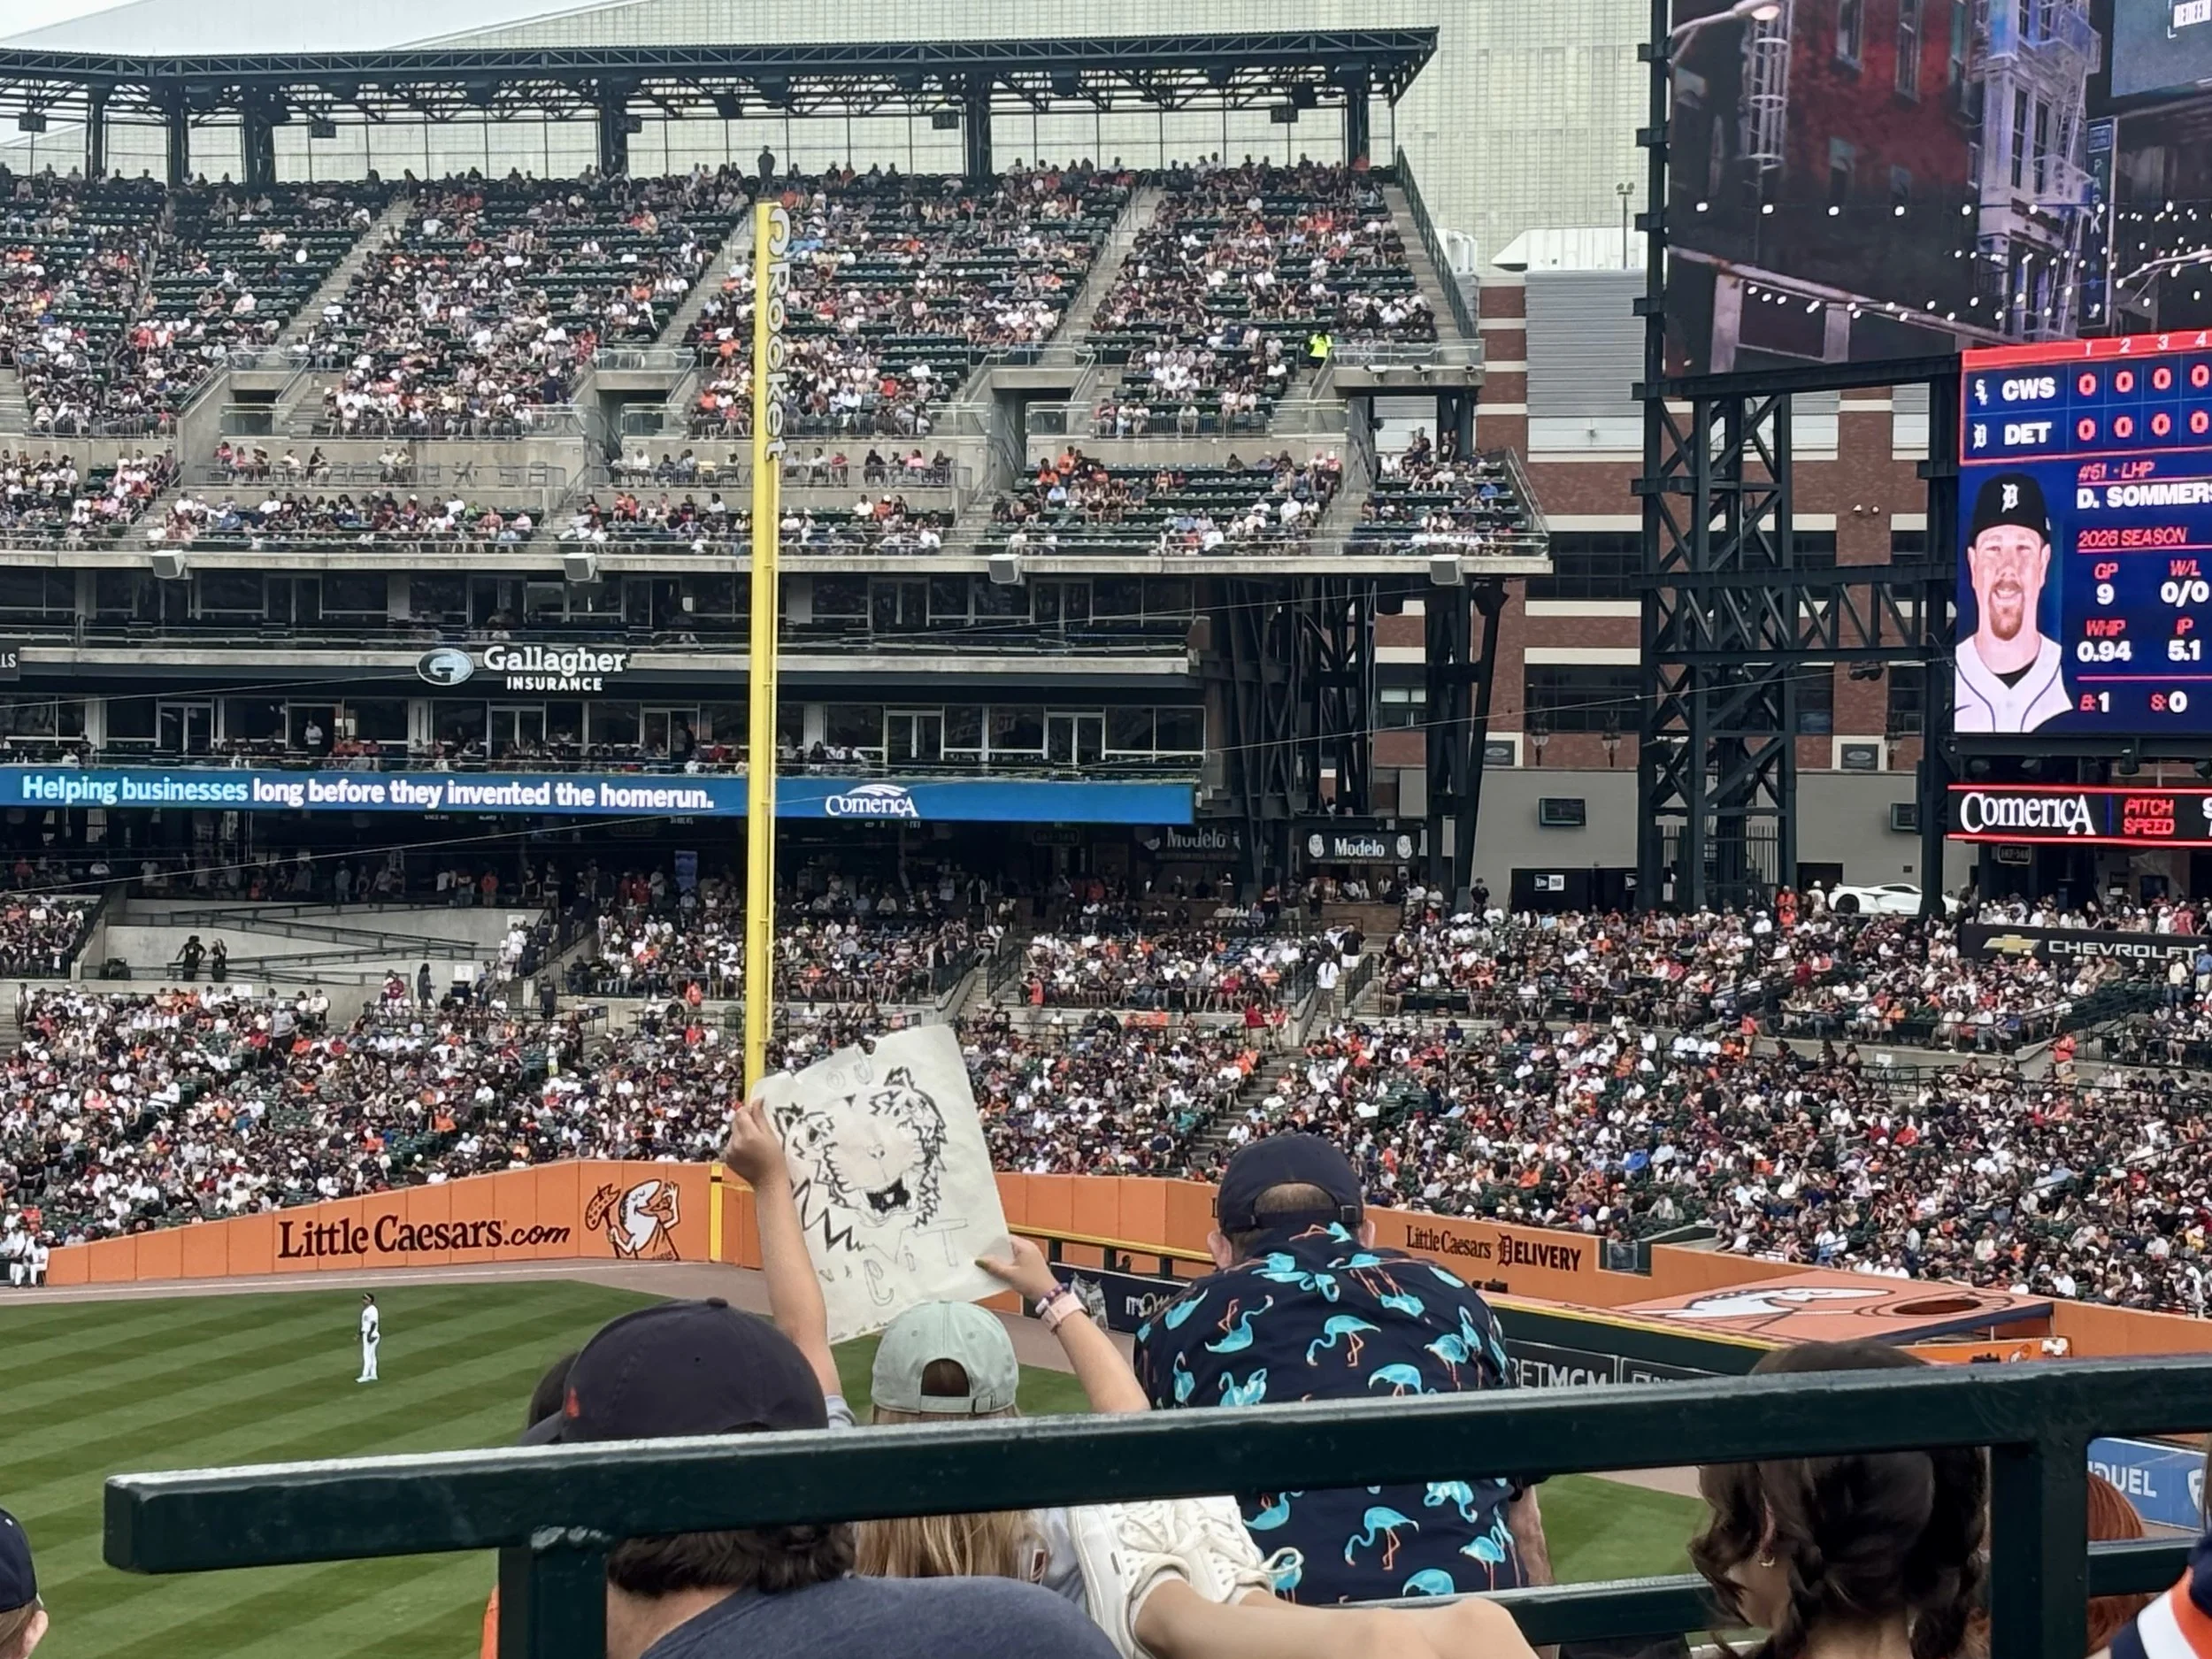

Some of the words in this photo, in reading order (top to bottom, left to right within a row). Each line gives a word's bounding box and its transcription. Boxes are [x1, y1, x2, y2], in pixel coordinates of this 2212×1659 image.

[2085, 341, 2093, 356] 1
[2119, 338, 2131, 354] 2
[2157, 334, 2169, 350] 3
[2195, 332, 2207, 348] 4
[2001, 377, 2055, 401] CWS
[2079, 373, 2096, 396] 0
[2116, 371, 2133, 393] 0
[2154, 367, 2171, 390] 0
[2192, 365, 2209, 388] 0
[2004, 421, 2052, 445] DET
[2078, 418, 2096, 441] 0
[2115, 416, 2132, 438] 0
[2152, 413, 2170, 436] 0
[2190, 411, 2208, 434] 0
[2121, 461, 2155, 479] LHP
[2077, 488, 2100, 509] D.
[2107, 482, 2212, 508] SOMMER
[2078, 529, 2119, 547] 2026
[2121, 526, 2188, 546] SEASON
[2094, 563, 2118, 580] GP
[2170, 559, 2201, 576] W/L
[2096, 583, 2115, 604] 9
[2160, 581, 2210, 607] 0/0
[2086, 619, 2126, 636] WHIP
[0, 653, 16, 668] LS
[482, 645, 627, 678] Gallagher
[2077, 641, 2132, 662] 0.94
[2168, 639, 2201, 660] 5.1
[506, 676, 603, 692] INSURANCE
[2098, 692, 2110, 712] 1
[2169, 690, 2188, 713] 0
[22, 775, 117, 803] Helping
[122, 777, 249, 803] businesses
[253, 777, 304, 808] long
[308, 778, 386, 805] before
[389, 780, 442, 810] they
[447, 780, 550, 808] invented
[555, 782, 595, 807] the
[600, 783, 715, 809] homerun.
[2124, 798, 2175, 816] PITCH
[2123, 817, 2175, 835] SPEED
[1166, 826, 1227, 850] Modelo
[1333, 837, 1386, 858] Modelo
[2048, 941, 2200, 959] CHEVROLET
[278, 1217, 368, 1258] Little
[374, 1215, 571, 1254] Caesars.com
[1405, 1225, 1440, 1252] Little
[1441, 1231, 1492, 1259] Caesars
[1496, 1232, 1582, 1271] DELIVERY
